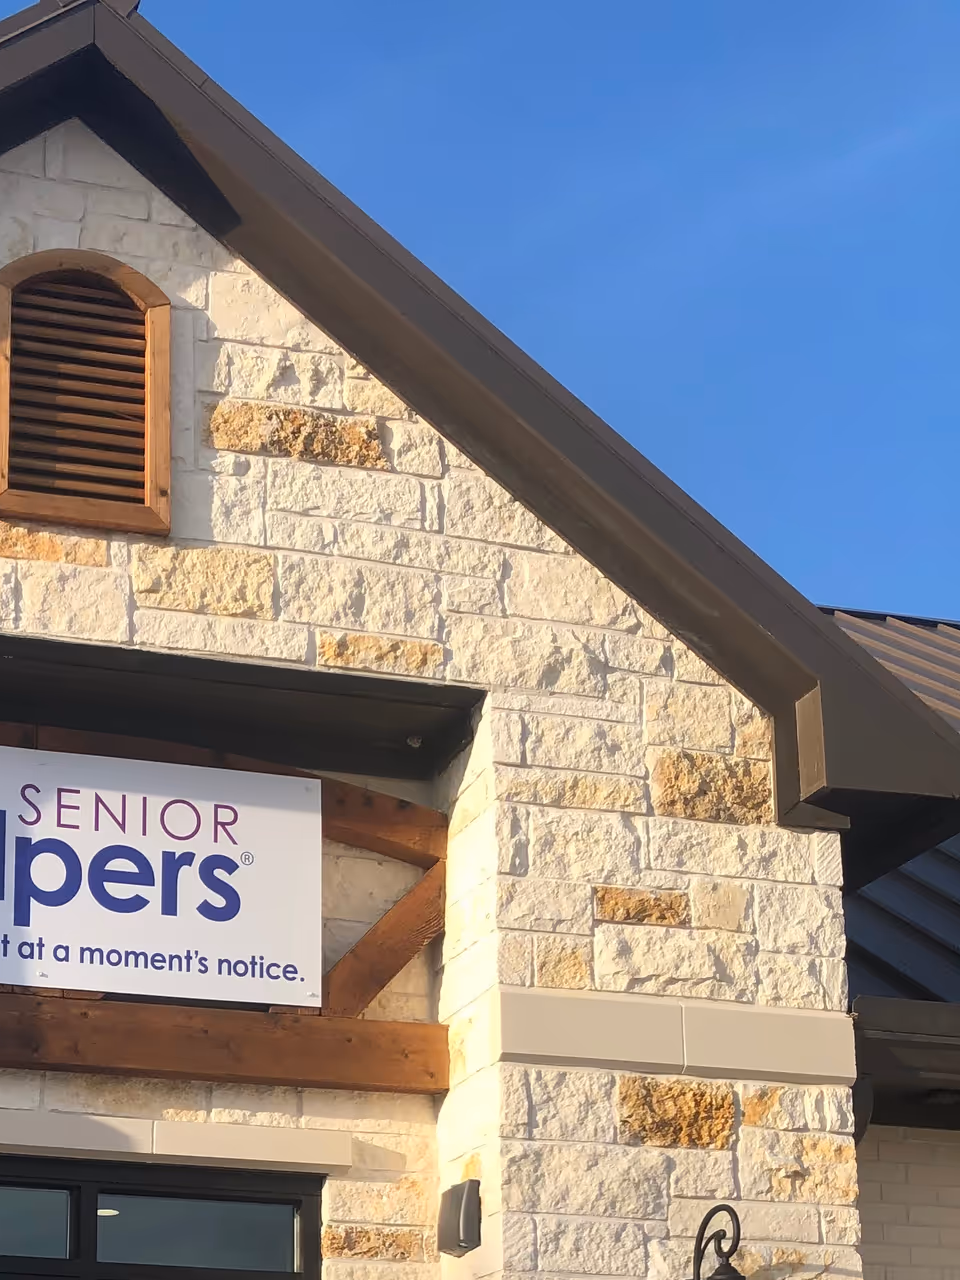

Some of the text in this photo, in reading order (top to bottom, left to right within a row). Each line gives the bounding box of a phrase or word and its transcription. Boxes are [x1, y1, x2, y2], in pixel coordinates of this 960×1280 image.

[18, 783, 240, 845] SENIOR
[17, 937, 45, 960] at
[52, 944, 70, 962] a
[79, 945, 209, 974] moment's
[217, 955, 306, 983] notice.
